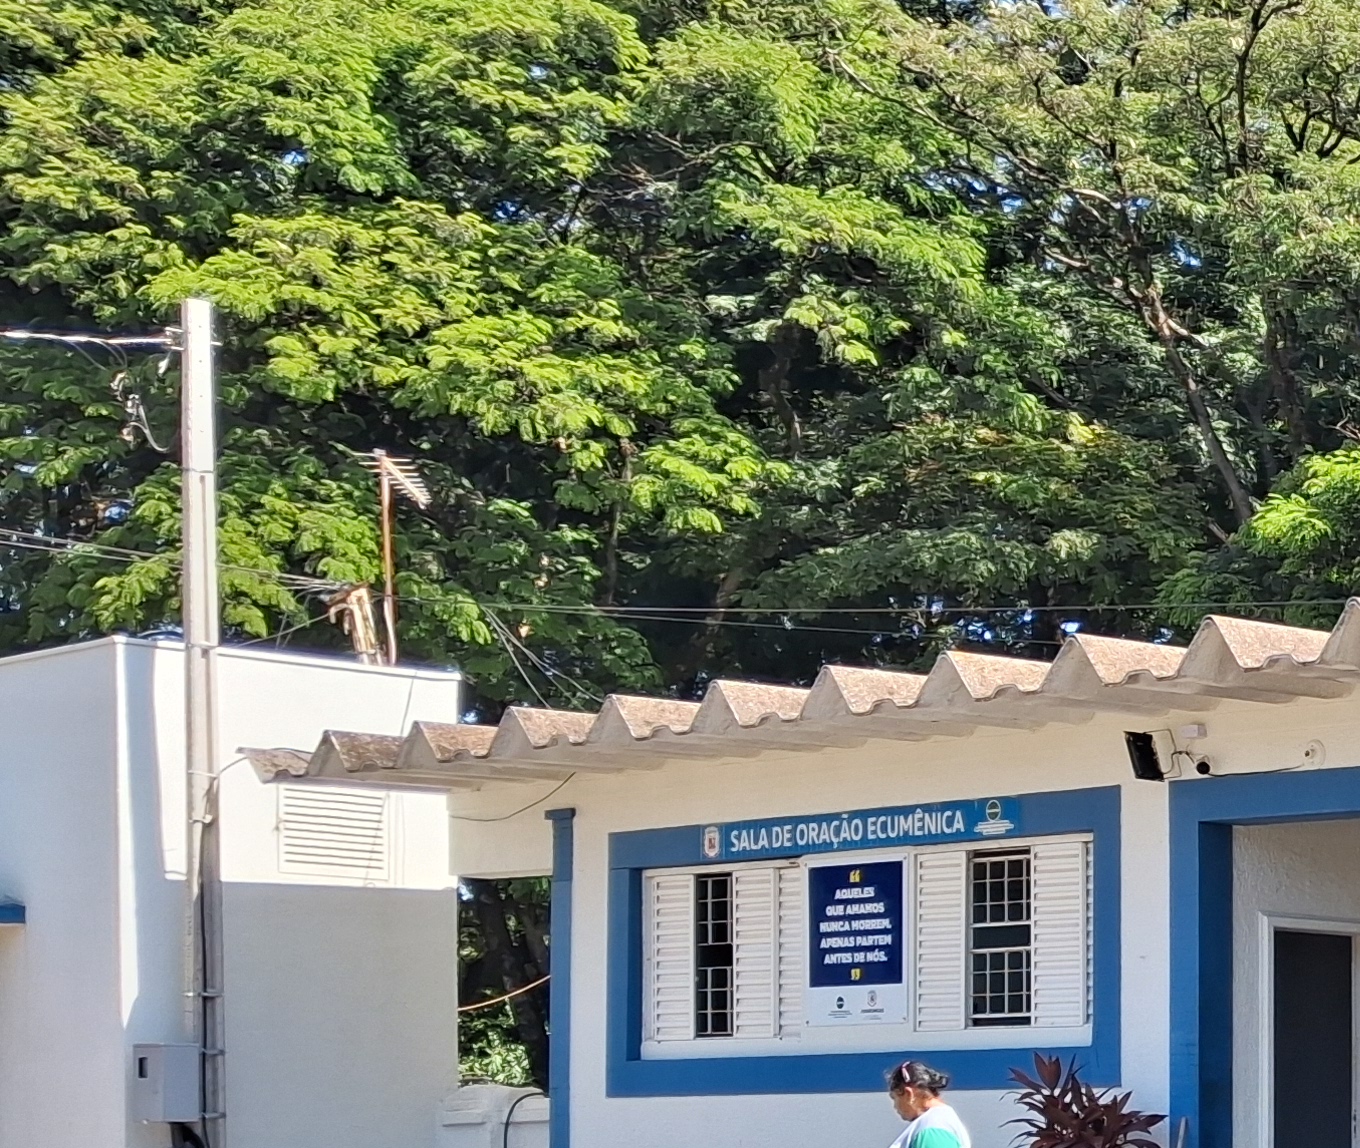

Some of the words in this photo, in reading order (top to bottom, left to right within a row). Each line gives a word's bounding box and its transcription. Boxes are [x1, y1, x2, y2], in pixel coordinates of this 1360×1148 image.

[730, 828, 769, 852] SALA
[771, 825, 793, 849] DE
[796, 813, 863, 848] ORAÇÃO
[867, 808, 966, 840] ECUMÊNICA
[834, 886, 875, 900] AQUELES
[825, 904, 845, 917] QUE
[846, 902, 885, 915] AMAMOS
[819, 920, 851, 933] NUNCA
[819, 936, 855, 949] APENAS
[856, 934, 892, 947] PARTEM
[823, 952, 853, 965] ANTES
[853, 951, 866, 963] DE
